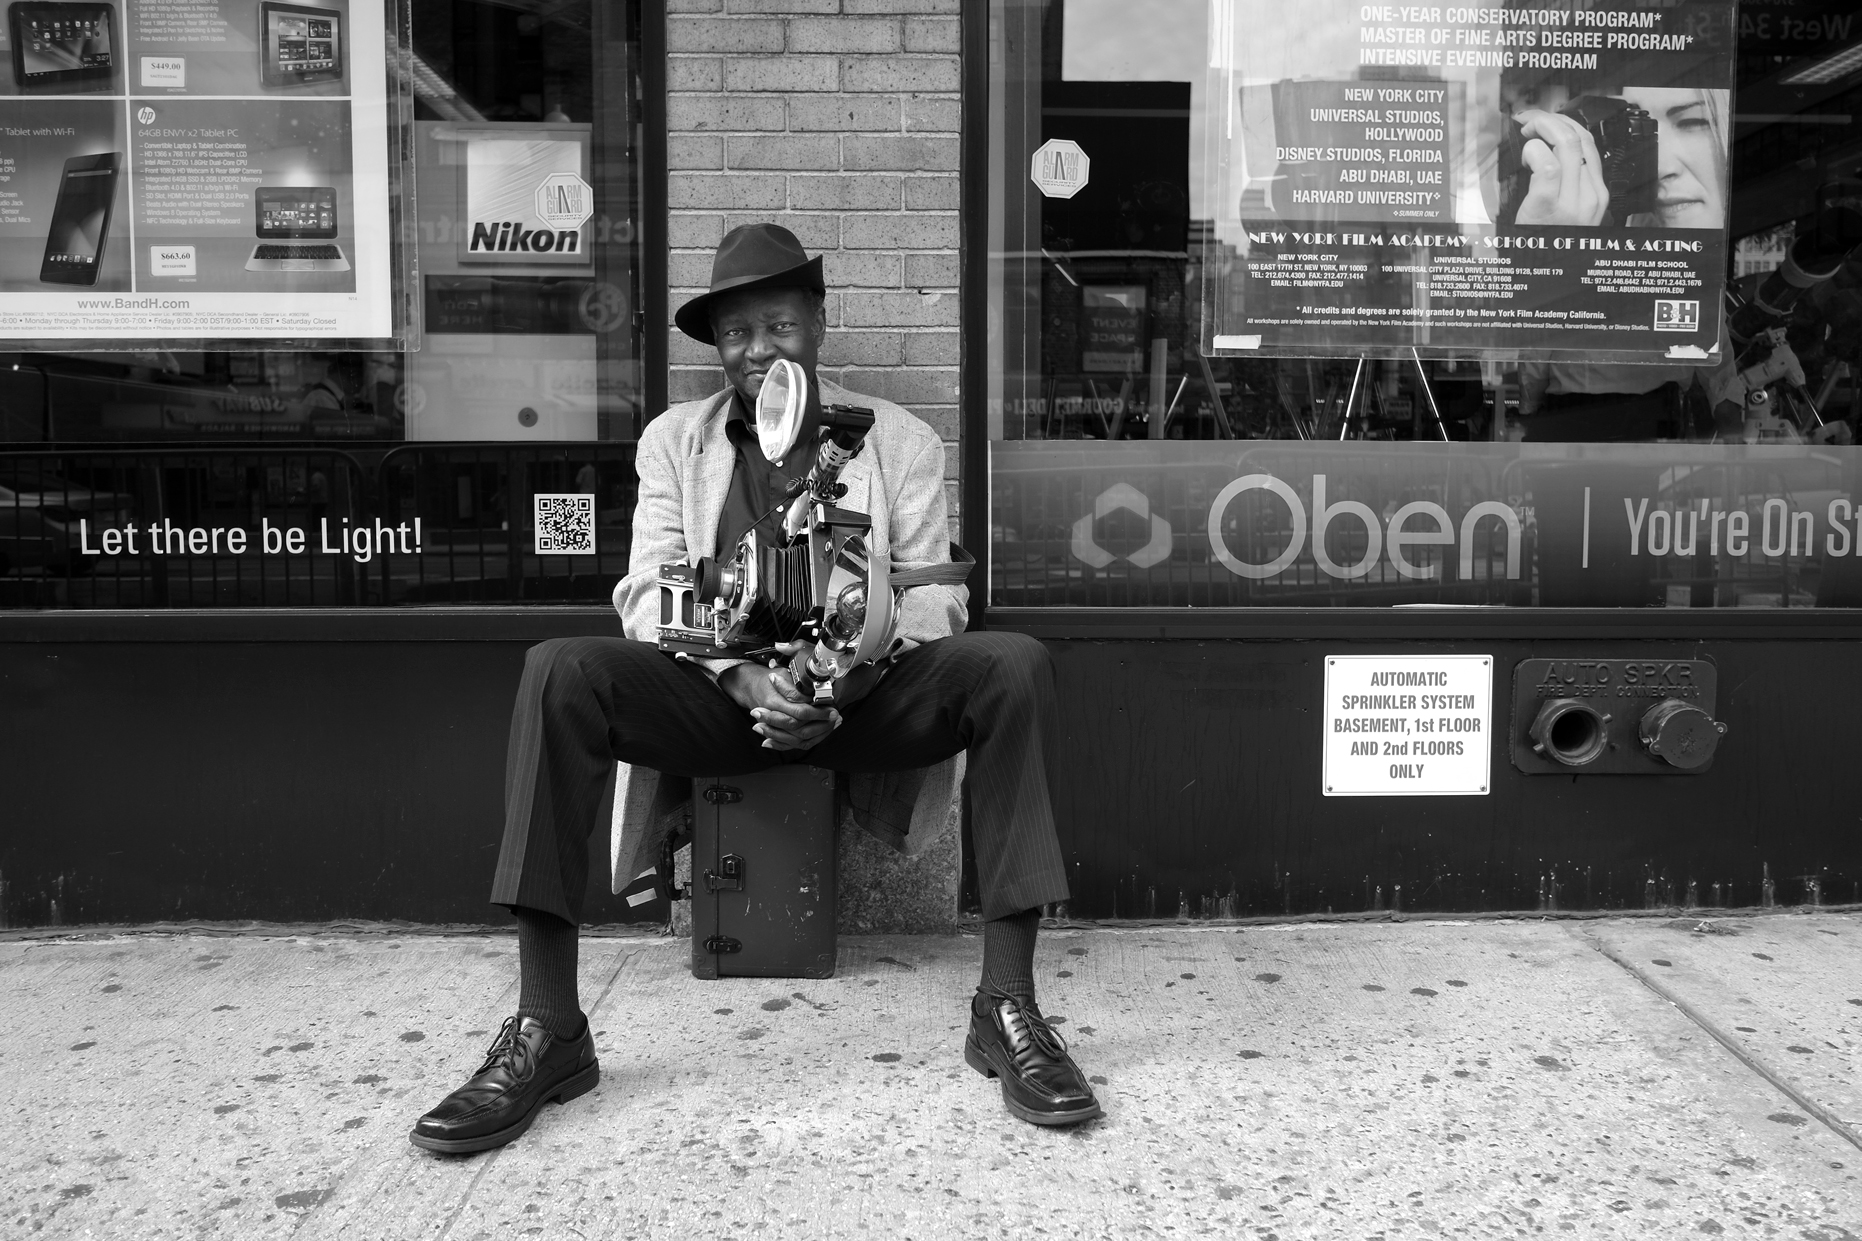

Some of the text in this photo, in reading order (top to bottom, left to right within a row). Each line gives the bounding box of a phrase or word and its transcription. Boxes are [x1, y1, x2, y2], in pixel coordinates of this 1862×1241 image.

[1360, 6, 1442, 25] ONE-YEAR
[1446, 8, 1570, 27] CONSERVATORY
[1360, 27, 1427, 46] MASTER
[1430, 28, 1451, 46] OF
[1455, 29, 1491, 47] FINE
[1494, 30, 1536, 48] ARTS
[1540, 31, 1604, 50] DEGREE
[150, 62, 180, 70] $449.00
[1360, 48, 1598, 70] INTENSIVE EVENING PROGRAM
[1344, 88, 1444, 103] NEW YORK CITY
[139, 107, 155, 124] hp
[1310, 108, 1444, 126] UNIVERSAL STUDIOS,
[4, 128, 76, 136] Tablet with Wi-Fi
[138, 128, 240, 138] 64GB ENVY x2 Tablet PC
[1365, 127, 1444, 142] HOLLYWOOD
[1276, 146, 1443, 164] DISNEY STUDIOS, FLORIDA
[1340, 169, 1442, 184] ABU DHABI, UAE
[546, 185, 581, 199] ALARM
[1292, 190, 1353, 204] HARVARD
[546, 199, 582, 214] GUARD
[1398, 210, 1440, 218] SUMMER ONLY
[470, 222, 579, 252] Nikon
[1248, 232, 1471, 248] NEW YORK FILM ACADEMY
[1484, 236, 1704, 252] SCHOOL OF FILM & ACTING
[160, 252, 190, 260] $663.60
[1278, 254, 1338, 262] NEW YORK CITY
[1434, 256, 1512, 265] UNIVERSAL STUDIOS
[1637, 260, 1655, 268] FILM
[1657, 260, 1688, 268] SCHOOL
[77, 298, 190, 309] www.BandH.com
[1313, 306, 1339, 314] credits
[1341, 306, 1355, 314] and
[1356, 306, 1386, 316] degrees
[1402, 307, 1424, 317] solely
[1424, 307, 1454, 317] granted
[1455, 308, 1465, 317] by
[1466, 308, 1478, 316] the
[1480, 308, 1496, 316] New
[1497, 308, 1515, 316] York
[1516, 308, 1532, 317] Film
[1534, 309, 1568, 319] Academy
[1569, 309, 1606, 318] California.
[24, 317, 147, 325] Monday through Thursday 9:00-7:00
[154, 317, 274, 326] Friday 9:00-2:00 DST/9:00-1:00 EST
[280, 317, 337, 326] Saturday Closed
[1208, 473, 1520, 580] Oben
[1624, 498, 1749, 557] You're
[1762, 498, 1814, 557] On
[80, 518, 423, 563] Let there be Light!
[1370, 672, 1448, 686] AUTOMATIC
[1543, 662, 1610, 684] AUTO
[1342, 695, 1475, 710] SPRINKLER SYSTEM
[1334, 718, 1480, 735] BASEMENT, 1st FLOOR
[1350, 741, 1464, 756] AND 2nd FLOORS
[1390, 764, 1424, 778] ONLY
